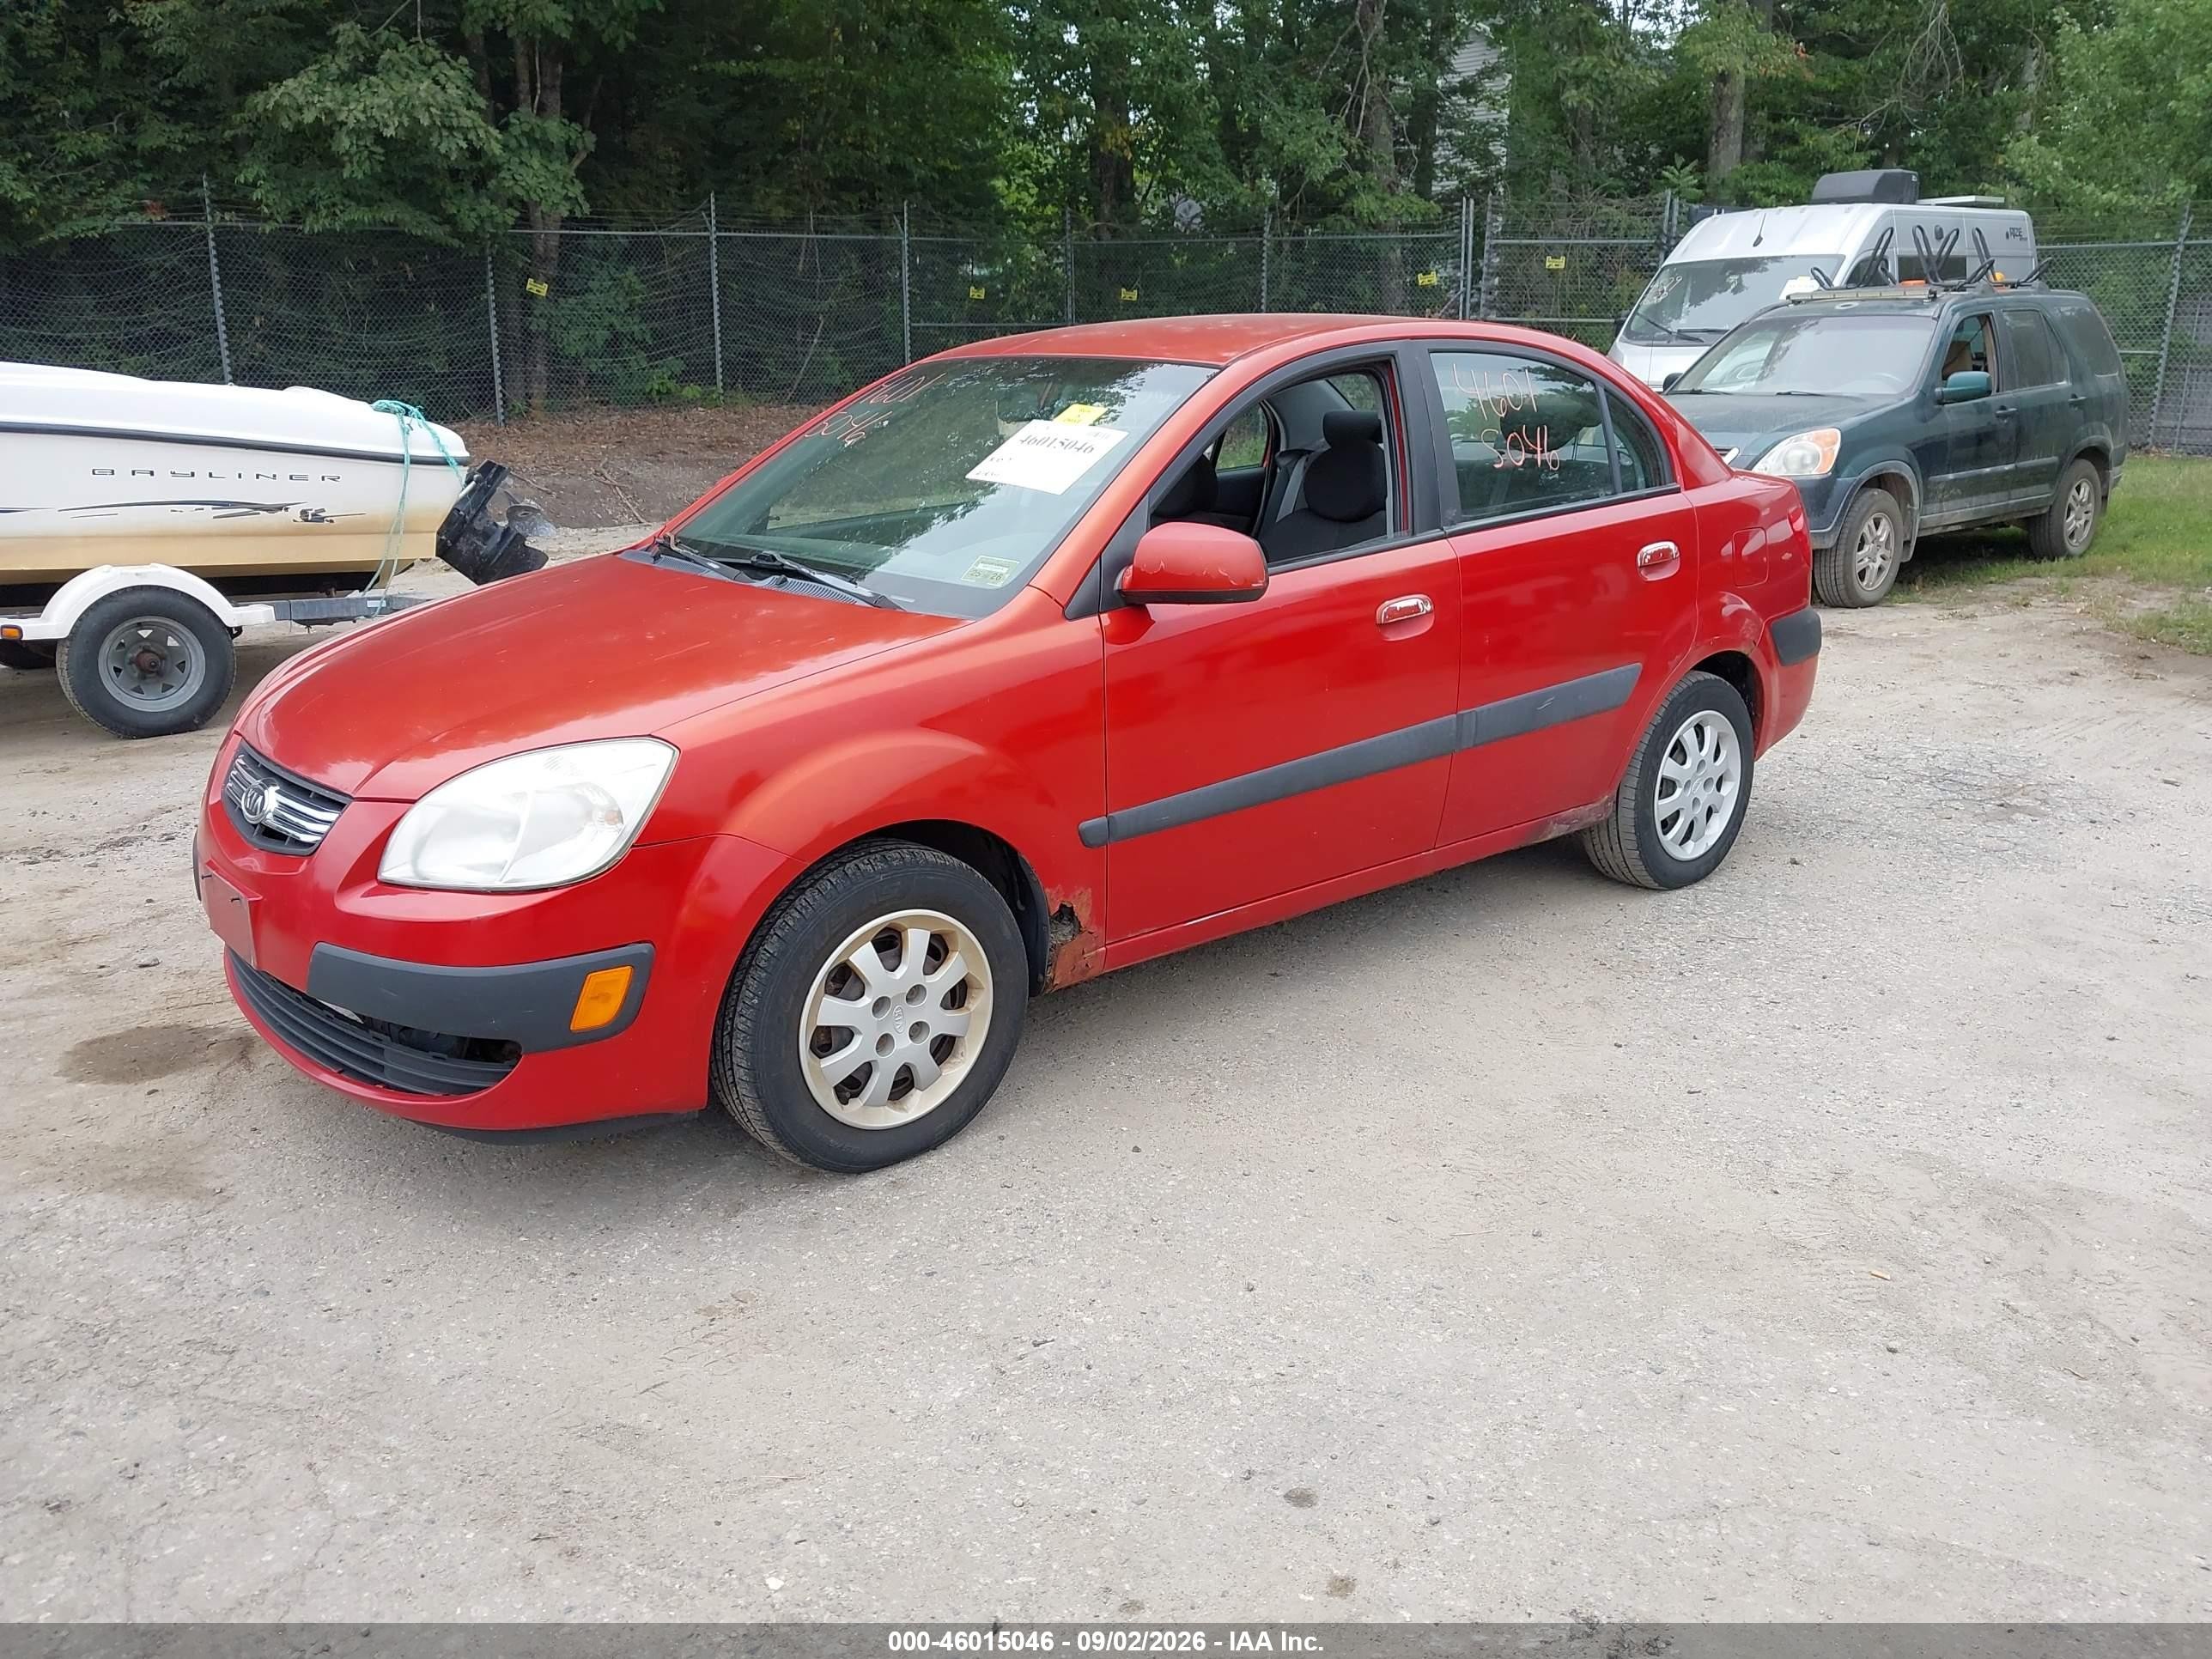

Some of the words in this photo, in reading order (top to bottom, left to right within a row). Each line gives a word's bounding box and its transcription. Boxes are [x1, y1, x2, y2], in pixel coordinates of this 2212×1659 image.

[1452, 363, 1538, 420] 4601
[1018, 434, 1096, 454] 46015046
[1480, 423, 1560, 471] 5046
[91, 468, 342, 483] BAYLINER
[895, 1008, 903, 1033] KIA
